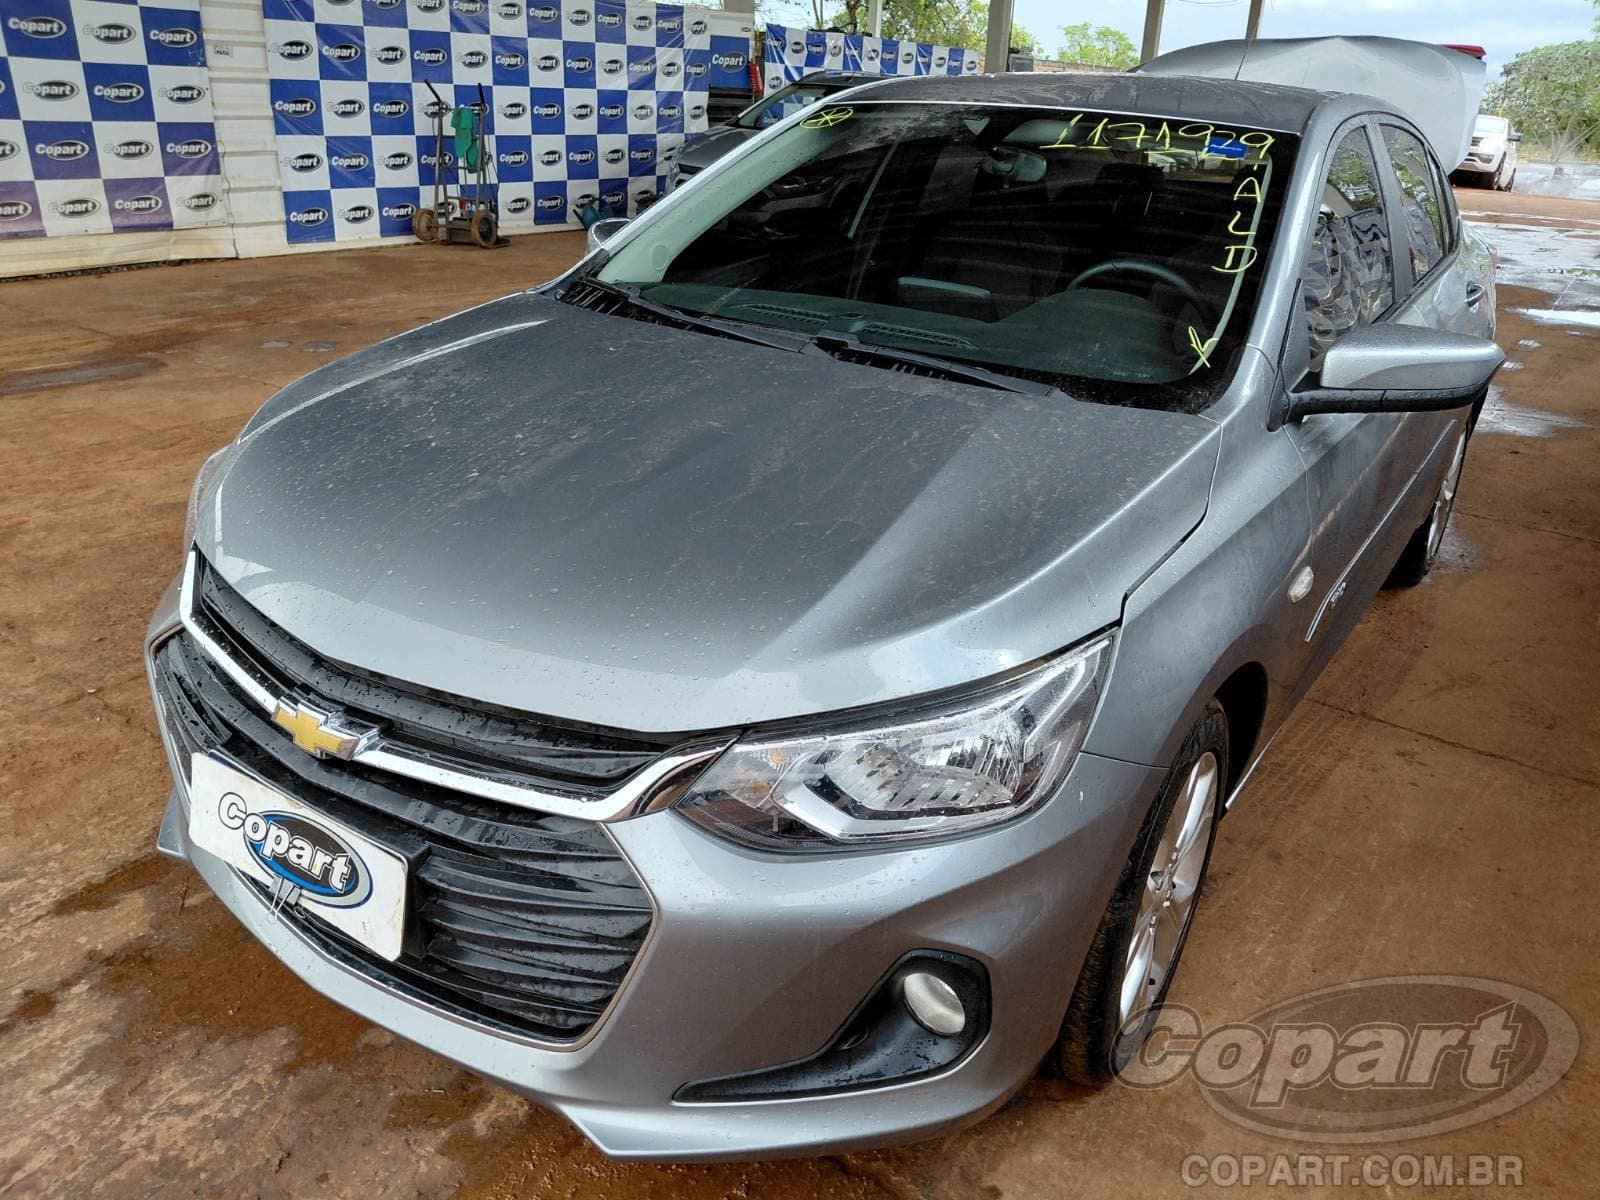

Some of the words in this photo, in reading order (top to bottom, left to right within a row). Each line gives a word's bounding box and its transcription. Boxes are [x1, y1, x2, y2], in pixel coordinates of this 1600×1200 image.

[529, 7, 555, 19] Copart
[597, 14, 620, 25] Copart
[8, 17, 59, 33] Copart
[84, 24, 129, 39] Copart
[150, 29, 192, 43] Copart
[271, 42, 307, 55] Copart
[322, 46, 355, 59] Copart
[370, 49, 401, 61] Copart
[414, 51, 443, 62] Copart
[495, 55, 521, 67] Copart
[712, 54, 743, 68] Copart
[566, 60, 590, 71] Copart
[24, 81, 72, 97] Copart
[94, 85, 138, 100] Copart
[160, 87, 199, 101] Copart
[275, 101, 311, 113] Copart
[327, 103, 360, 114] Copart
[373, 101, 405, 114] Copart
[534, 105, 558, 117] Copart
[600, 105, 621, 117] Copart
[35, 143, 84, 157] Copart
[104, 143, 147, 157] Copart
[166, 142, 207, 155] Copart
[283, 155, 319, 168] Copart
[332, 155, 365, 168] Copart
[379, 153, 409, 166] Copart
[500, 153, 526, 165] Copart
[569, 151, 592, 163] Copart
[631, 151, 652, 161] Copart
[50, 201, 95, 215] Copart
[115, 199, 158, 213] Copart
[177, 196, 213, 208] Copart
[538, 198, 561, 211] Copart
[290, 210, 324, 223] Copart
[337, 208, 370, 220] Copart
[382, 205, 412, 219] Copart
[218, 791, 352, 894] Copart
